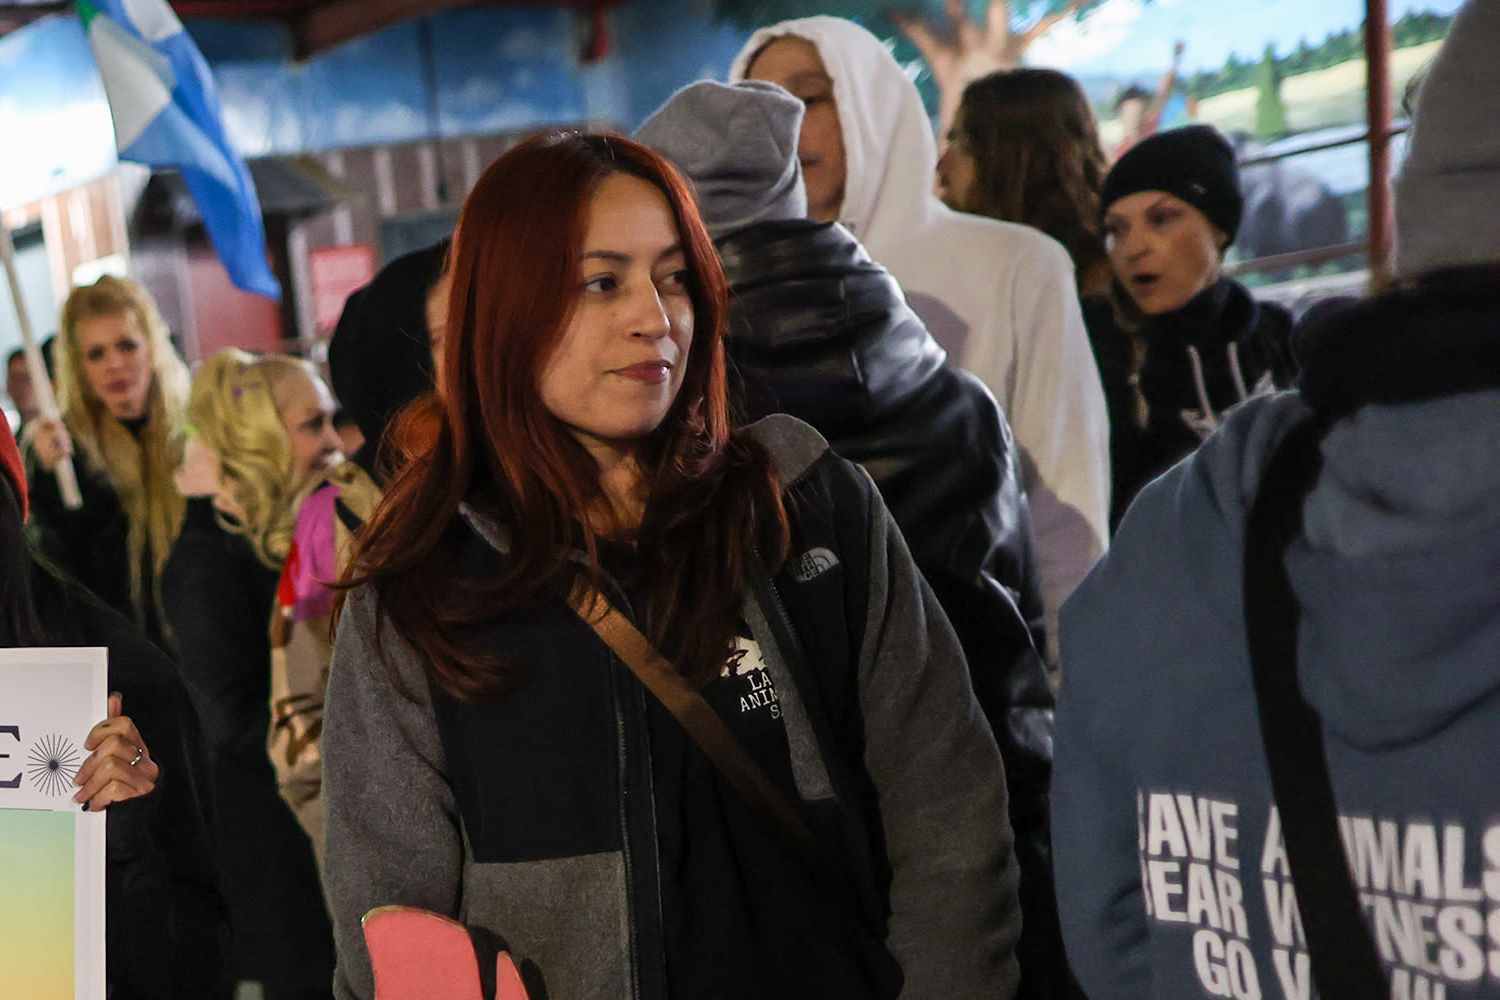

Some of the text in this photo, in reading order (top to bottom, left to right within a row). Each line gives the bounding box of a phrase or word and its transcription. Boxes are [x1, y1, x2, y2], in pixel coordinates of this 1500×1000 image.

[747, 671, 772, 691] LA
[1137, 788, 1240, 870] AVE
[1140, 859, 1250, 940] EAR
